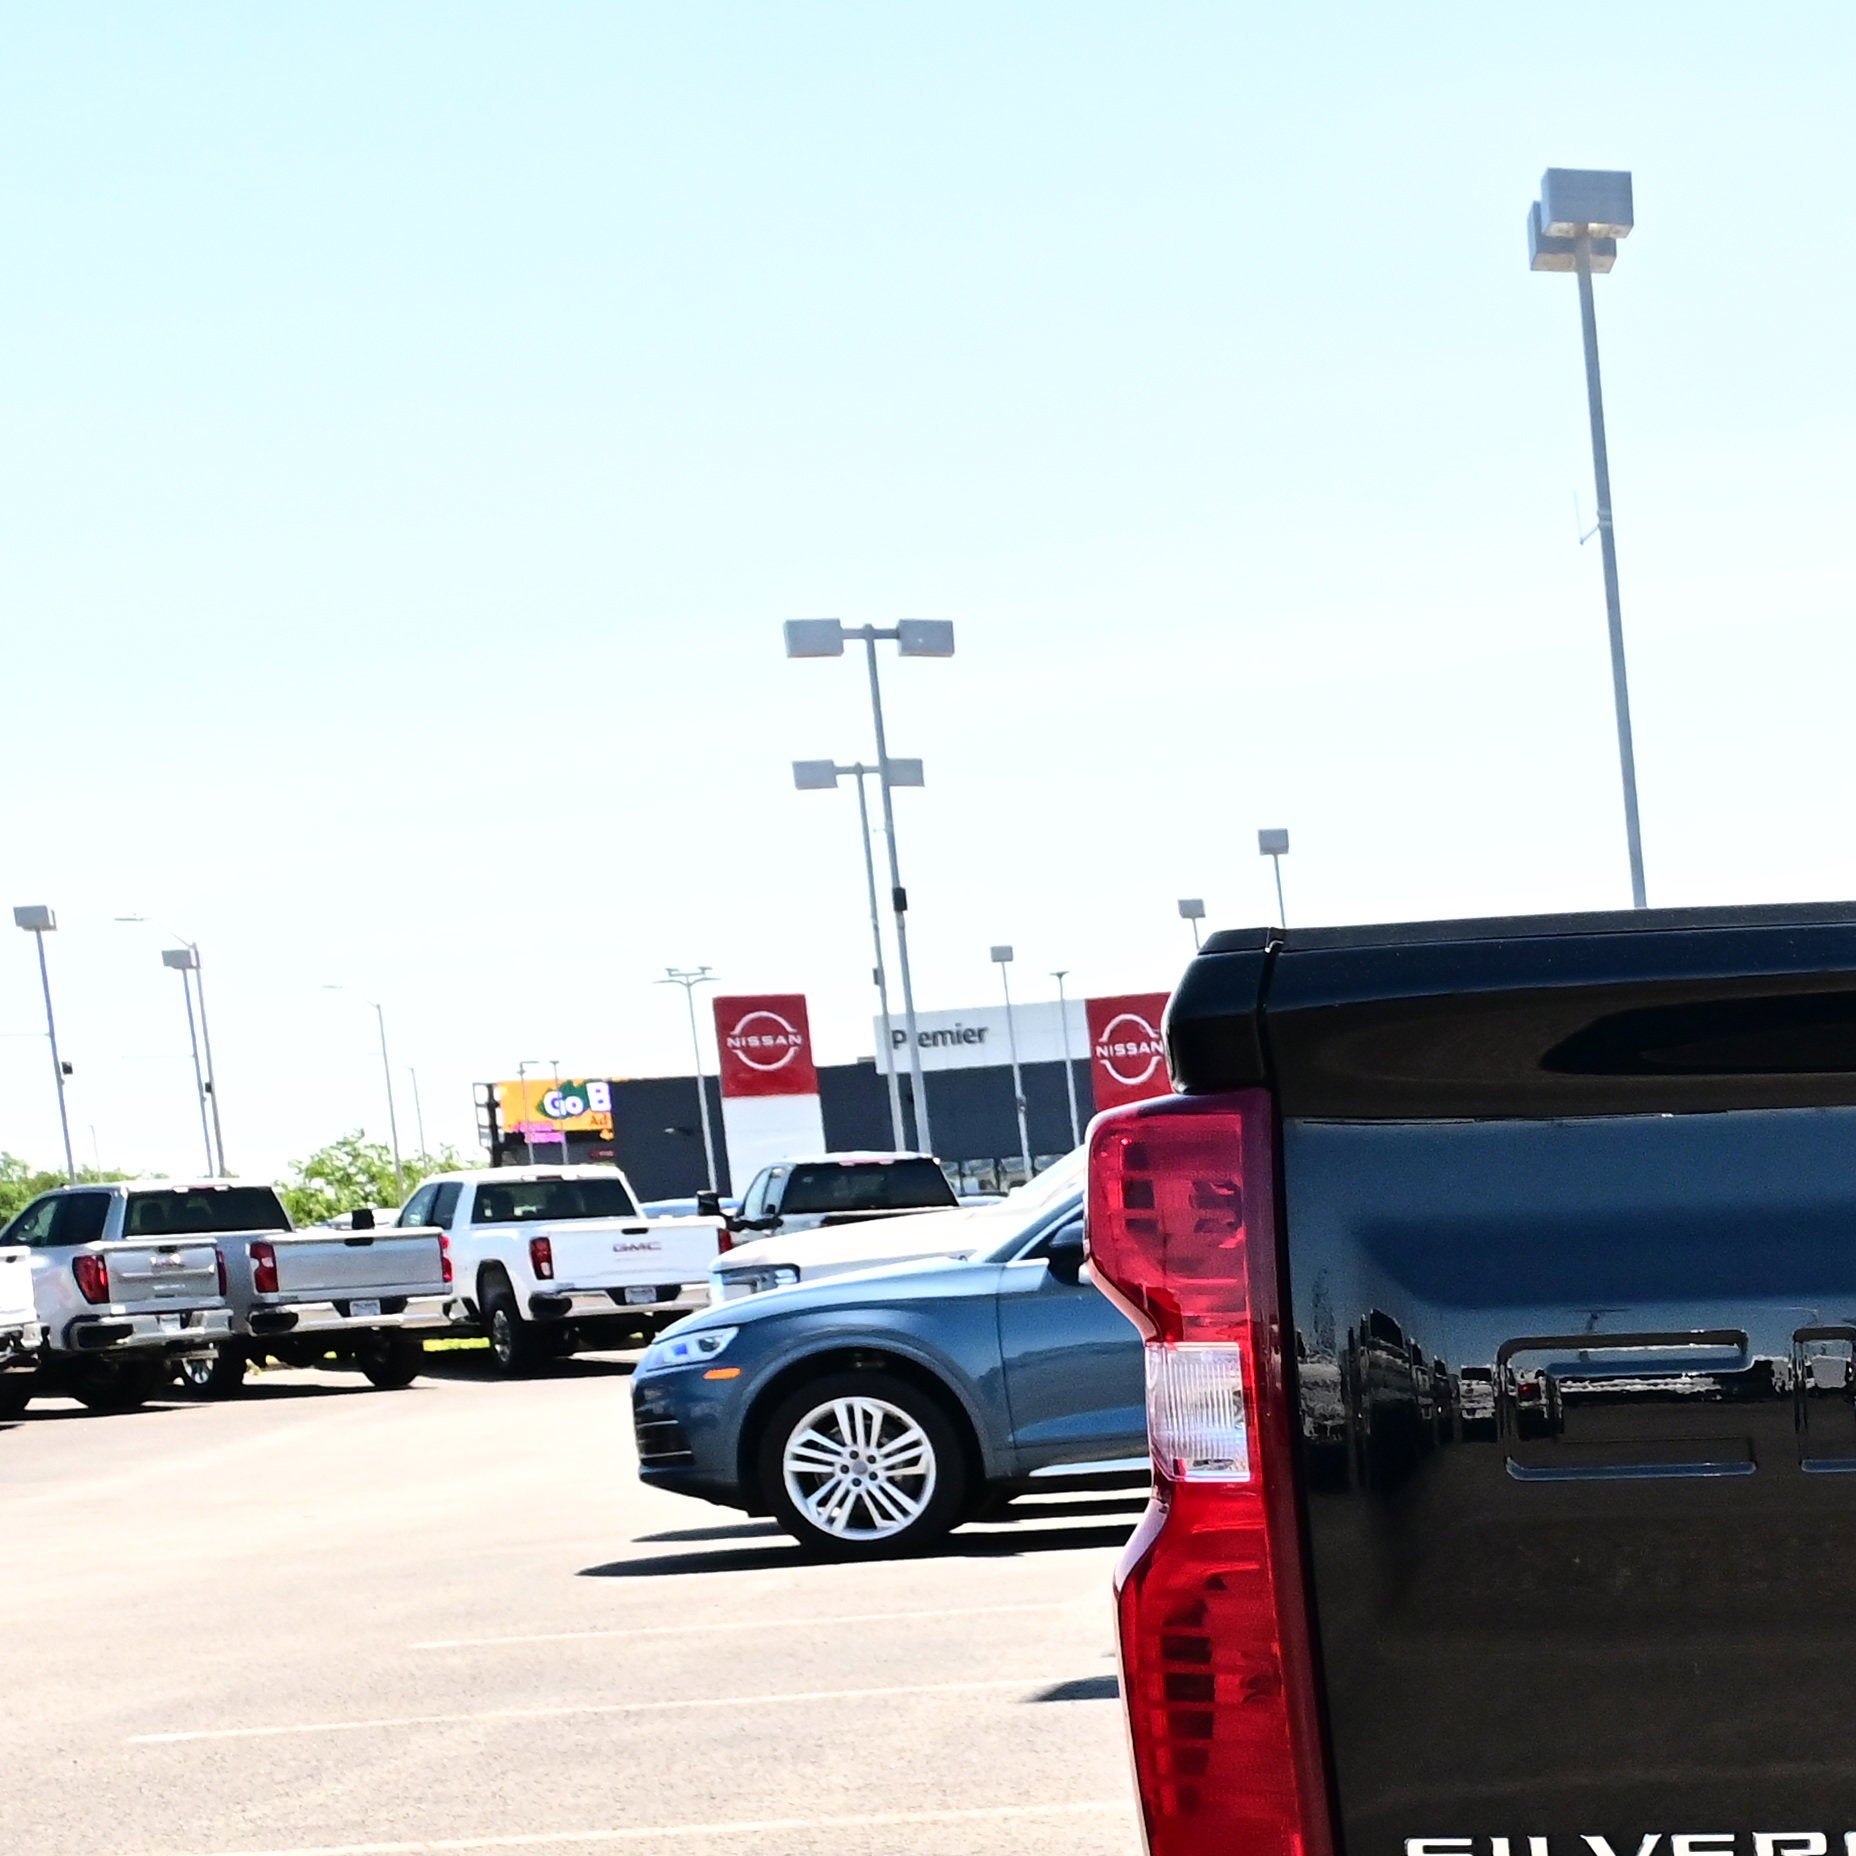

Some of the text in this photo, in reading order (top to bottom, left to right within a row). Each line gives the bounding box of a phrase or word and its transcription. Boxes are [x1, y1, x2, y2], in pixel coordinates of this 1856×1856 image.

[726, 1034, 802, 1049] NISSAN
[892, 1022, 989, 1050] Pemier
[1095, 1040, 1164, 1058] NISSAN
[612, 1241, 662, 1253] GMC
